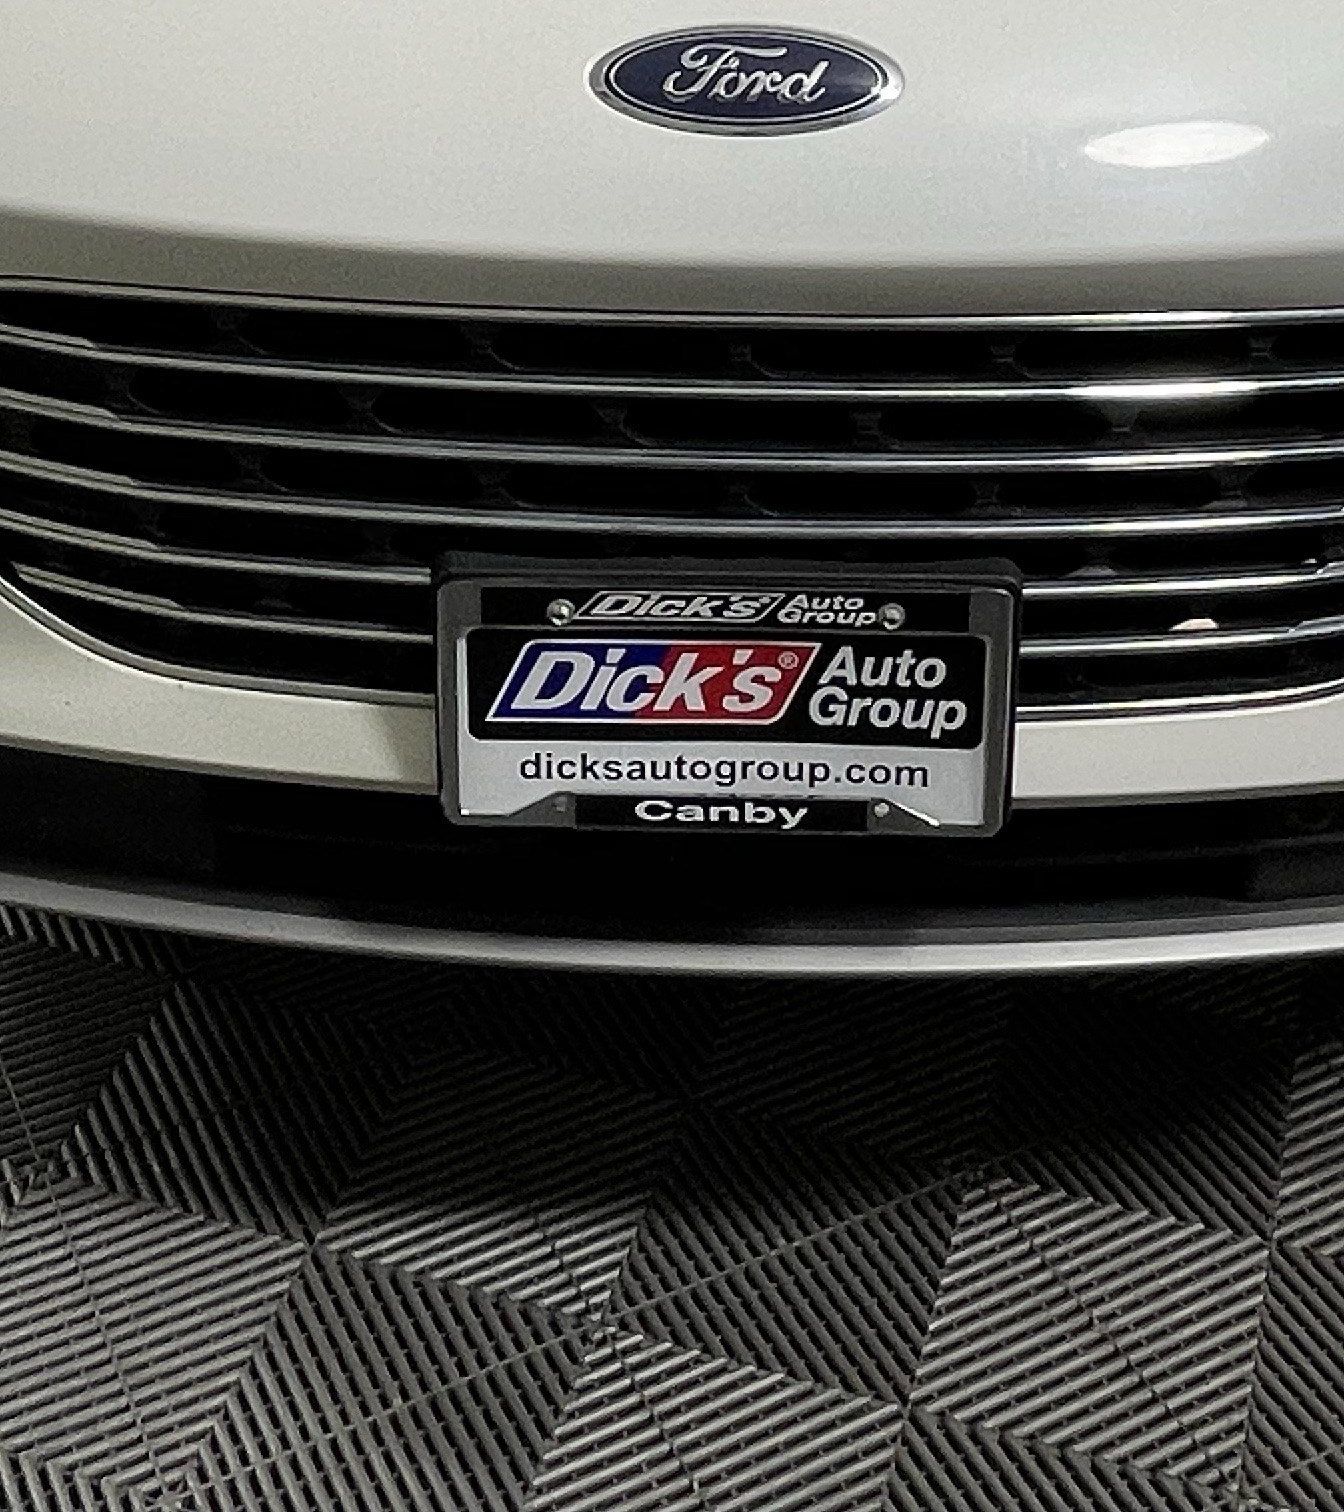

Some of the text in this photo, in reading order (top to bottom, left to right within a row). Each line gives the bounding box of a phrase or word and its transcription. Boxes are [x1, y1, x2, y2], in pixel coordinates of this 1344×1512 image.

[663, 43, 829, 104] Ford
[777, 608, 877, 627] Group
[790, 594, 864, 610] Auto
[819, 646, 946, 688] Auto
[808, 687, 967, 739] Group
[519, 752, 930, 788] dicksautogroup.com
[634, 799, 809, 829] Canby
